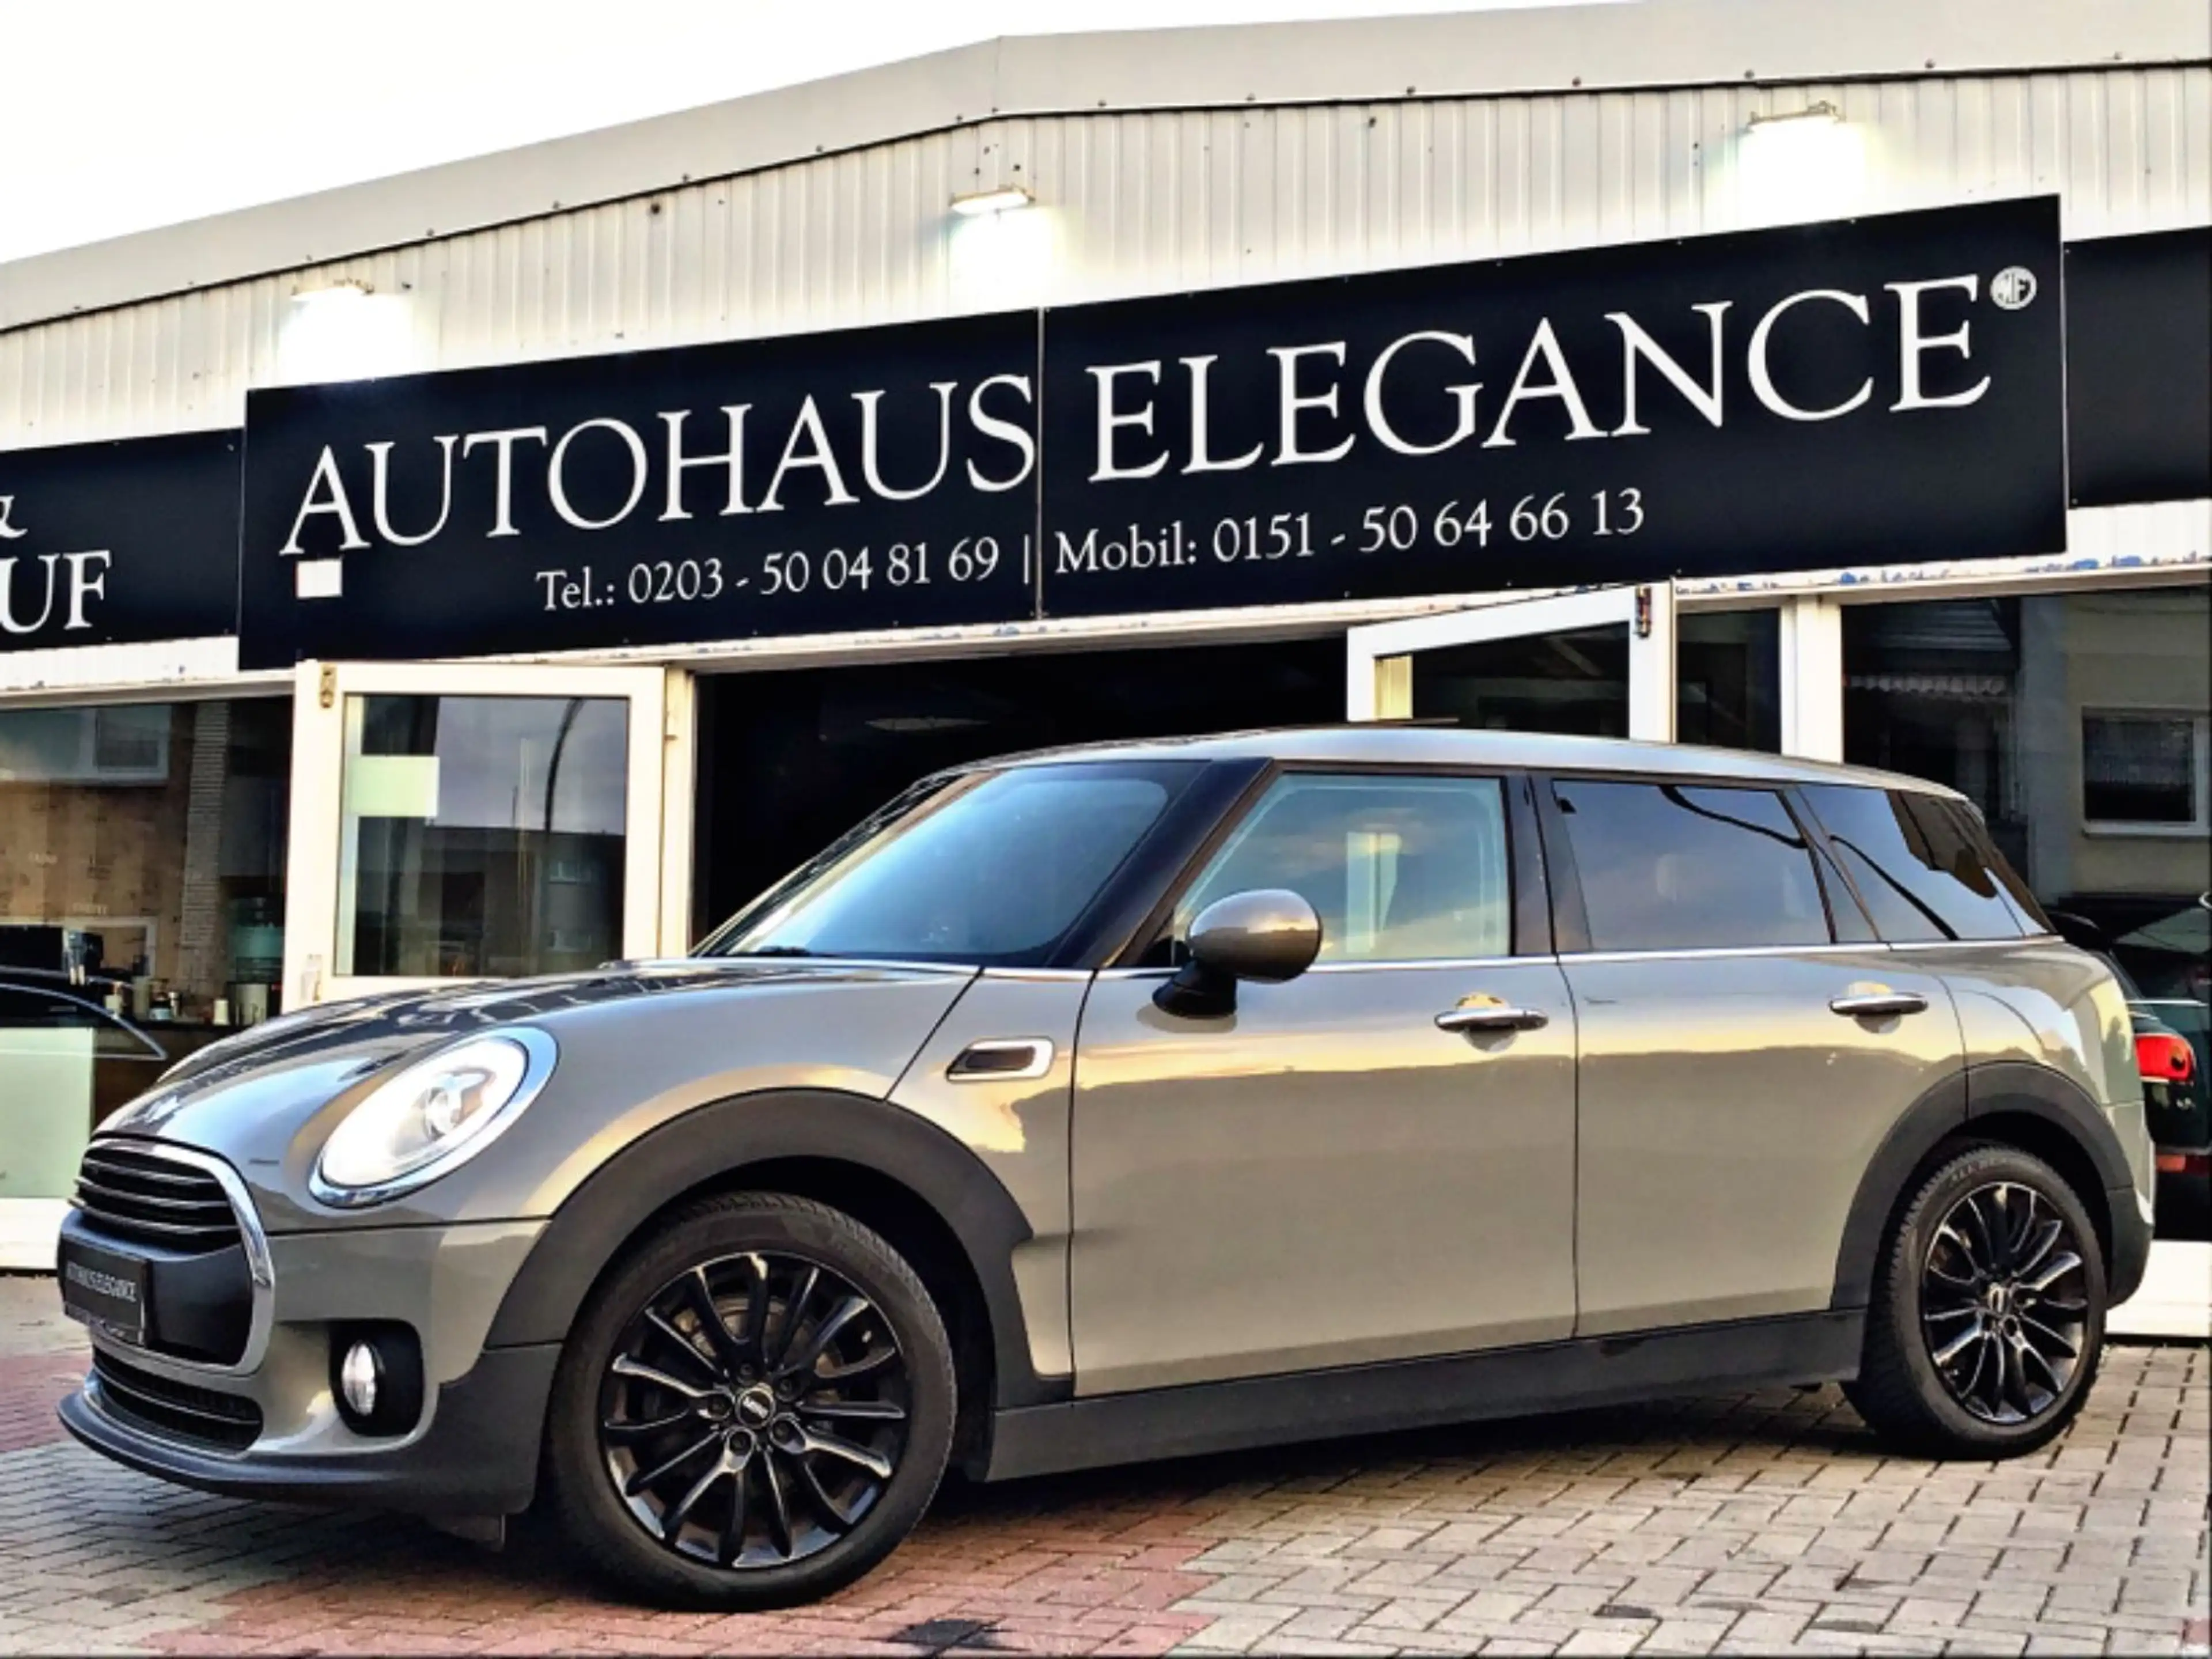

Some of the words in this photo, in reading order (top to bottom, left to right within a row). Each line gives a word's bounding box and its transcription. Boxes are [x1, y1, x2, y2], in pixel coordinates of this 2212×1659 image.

[279, 373, 1035, 555] AUTOHAUS
[1085, 274, 1991, 482] ELEGANCE
[536, 566, 615, 611] Tel.:
[628, 556, 722, 604] 0203
[759, 551, 809, 594] 50
[823, 547, 873, 590] 04
[887, 541, 930, 585] 81
[948, 536, 999, 581] 69
[1054, 520, 1197, 574] Mobil:
[1213, 512, 1314, 562] 0151
[1359, 505, 1418, 552] 50
[1433, 499, 1493, 547] 64
[1509, 491, 1570, 541] 66
[1591, 487, 1645, 536] 13
